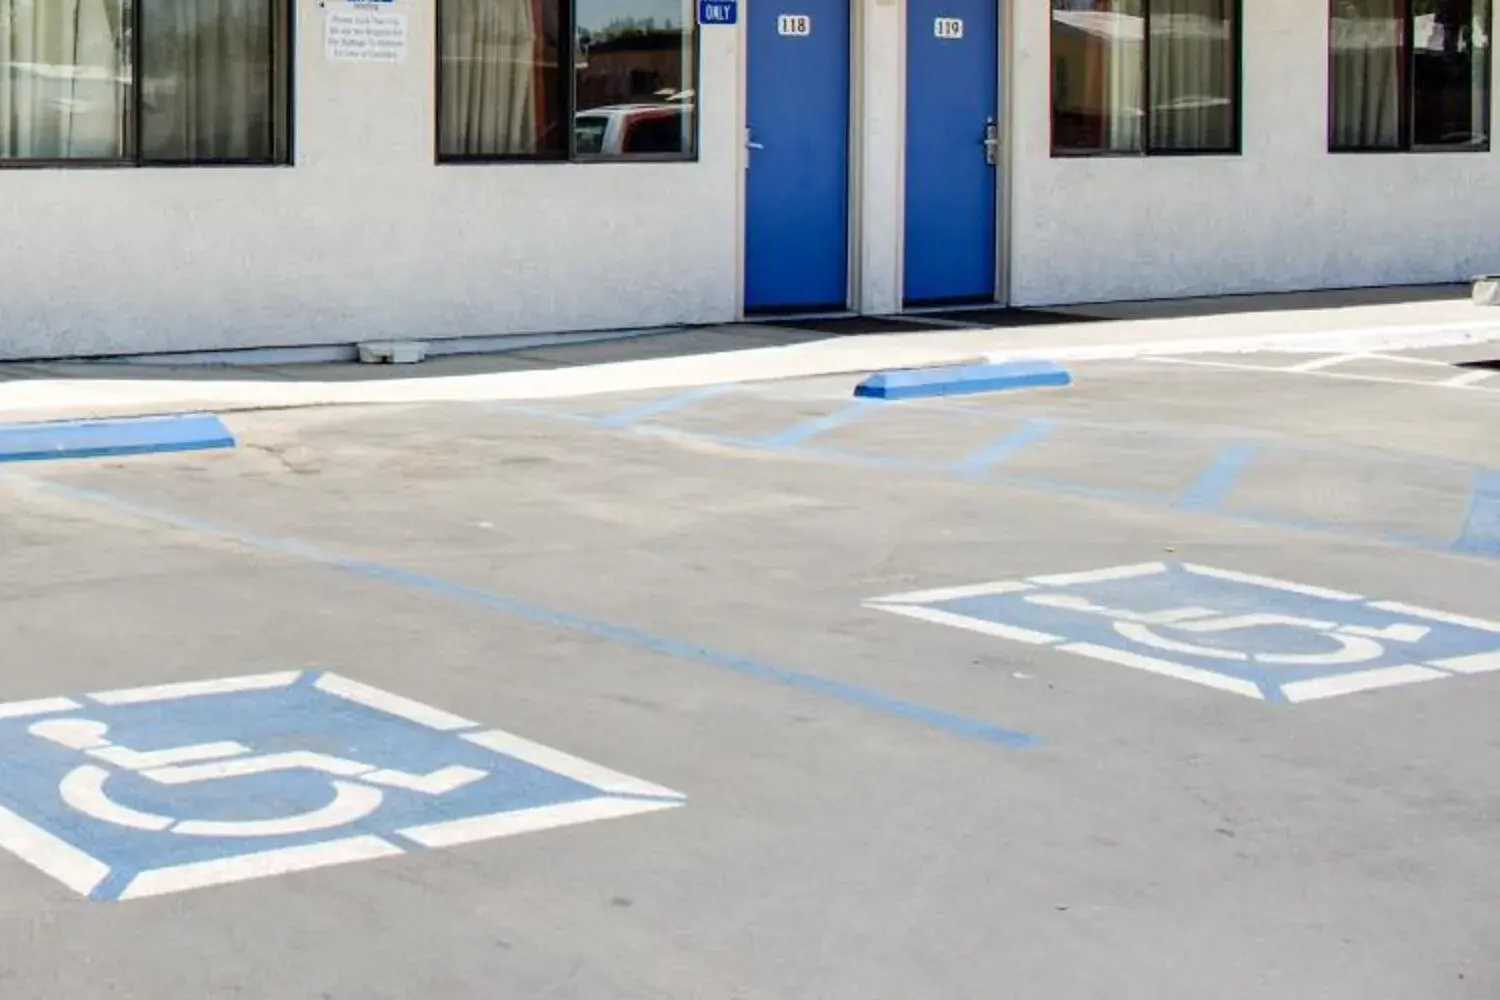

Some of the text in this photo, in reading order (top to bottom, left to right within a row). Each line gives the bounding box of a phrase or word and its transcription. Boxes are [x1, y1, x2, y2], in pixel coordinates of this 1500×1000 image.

[705, 3, 732, 21] ONLY
[781, 17, 806, 33] 118
[937, 20, 959, 36] 119
